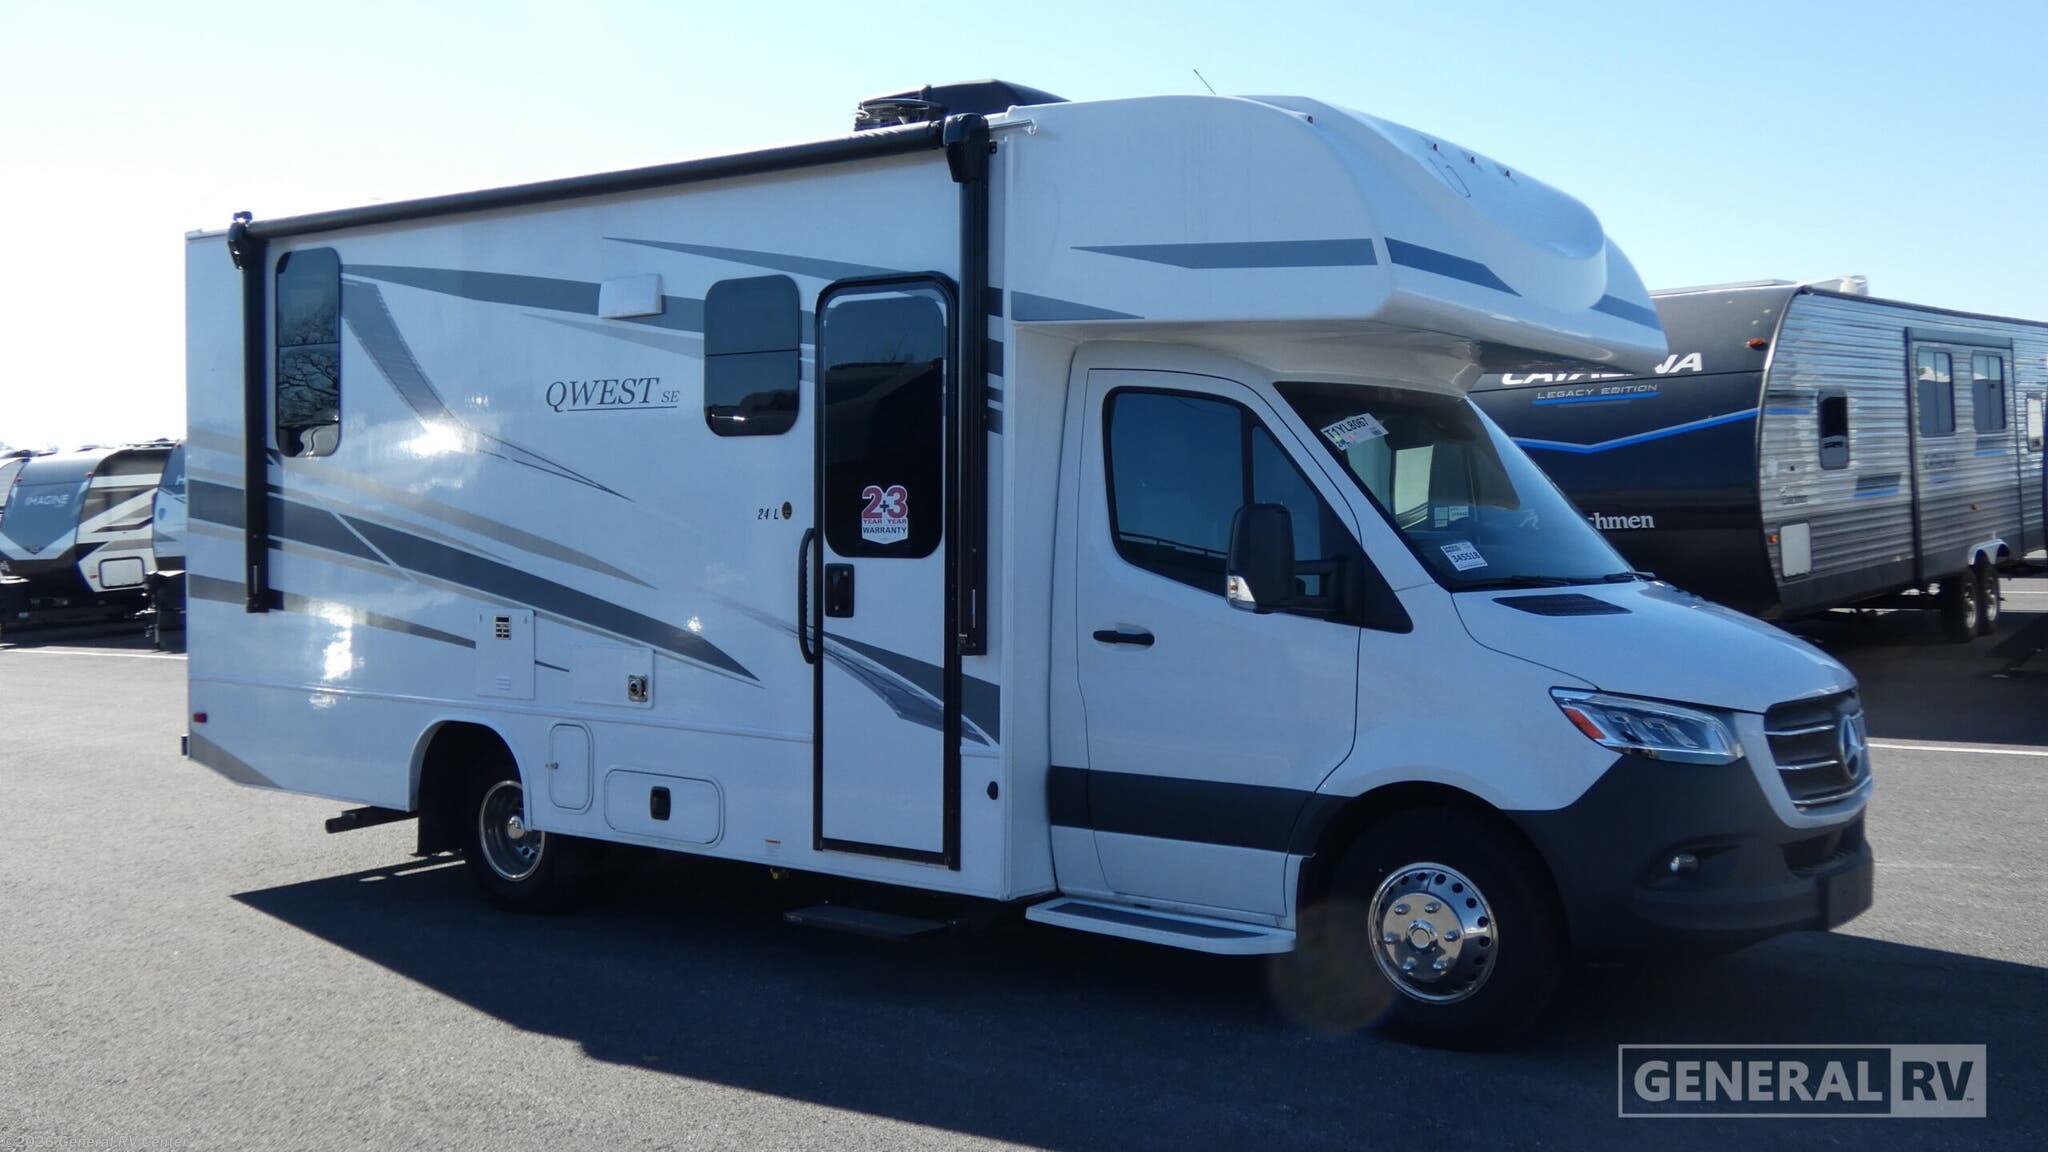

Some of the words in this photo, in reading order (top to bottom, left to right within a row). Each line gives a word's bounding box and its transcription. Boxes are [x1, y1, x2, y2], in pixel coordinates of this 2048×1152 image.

[546, 377, 659, 412] QWEST
[660, 390, 681, 403] SE
[1537, 389, 1595, 400] LEGACY
[1601, 384, 1658, 395] EDITION
[757, 508, 770, 521] 24
[773, 508, 780, 520] L
[862, 526, 907, 534] WARRANTY
